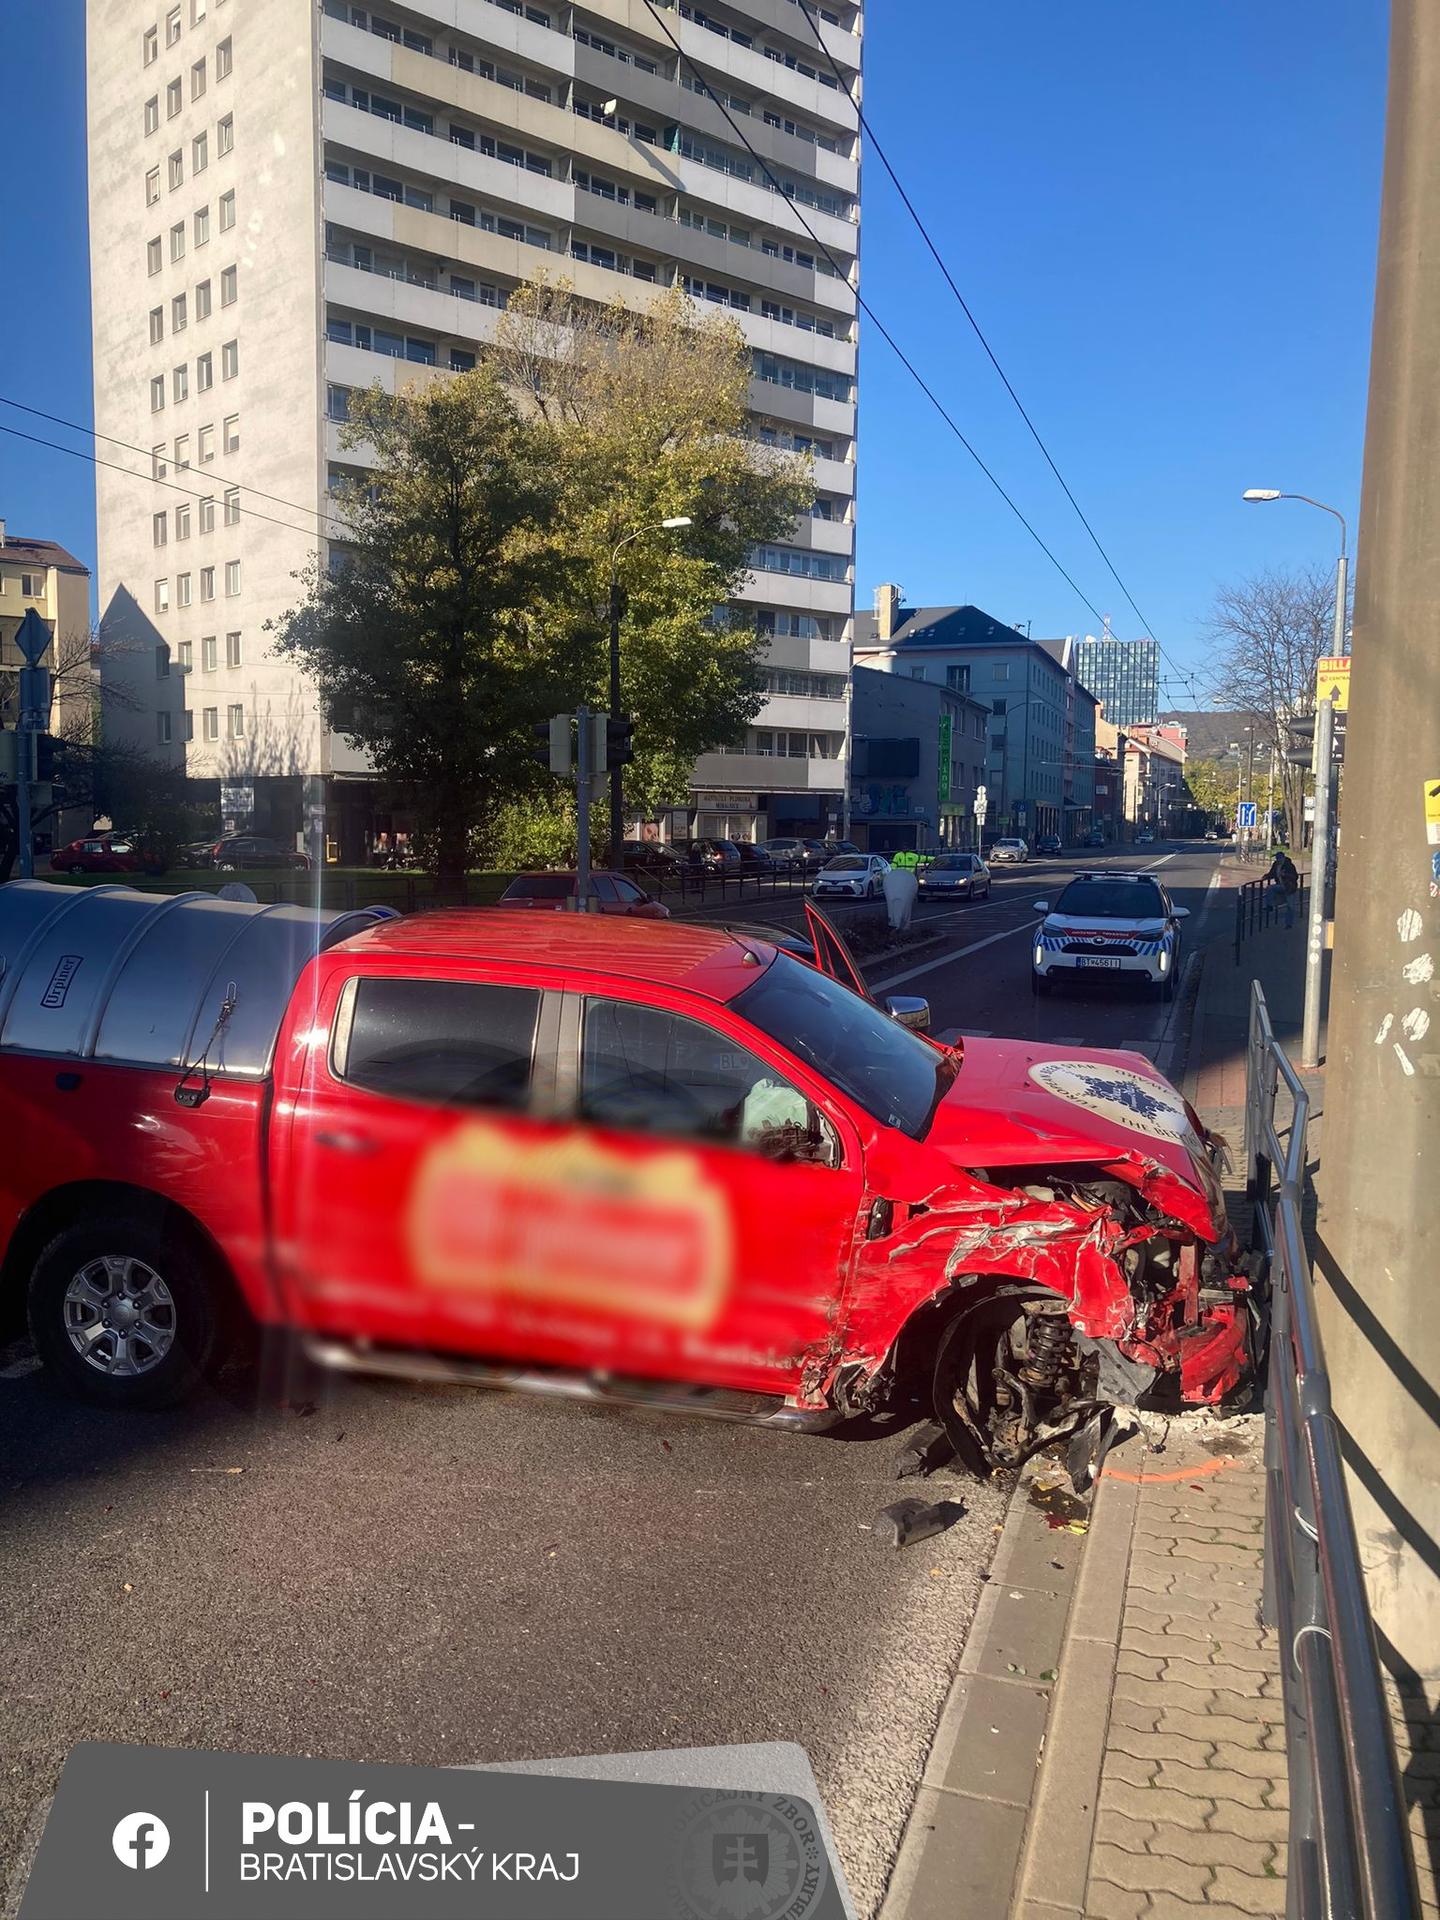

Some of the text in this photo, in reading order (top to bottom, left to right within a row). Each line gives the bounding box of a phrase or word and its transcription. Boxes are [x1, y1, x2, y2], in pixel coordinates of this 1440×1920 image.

[1320, 659, 1351, 671] BILLA
[45, 958, 74, 1004] Urpiner
[1120, 1116, 1184, 1140] THE BEE
